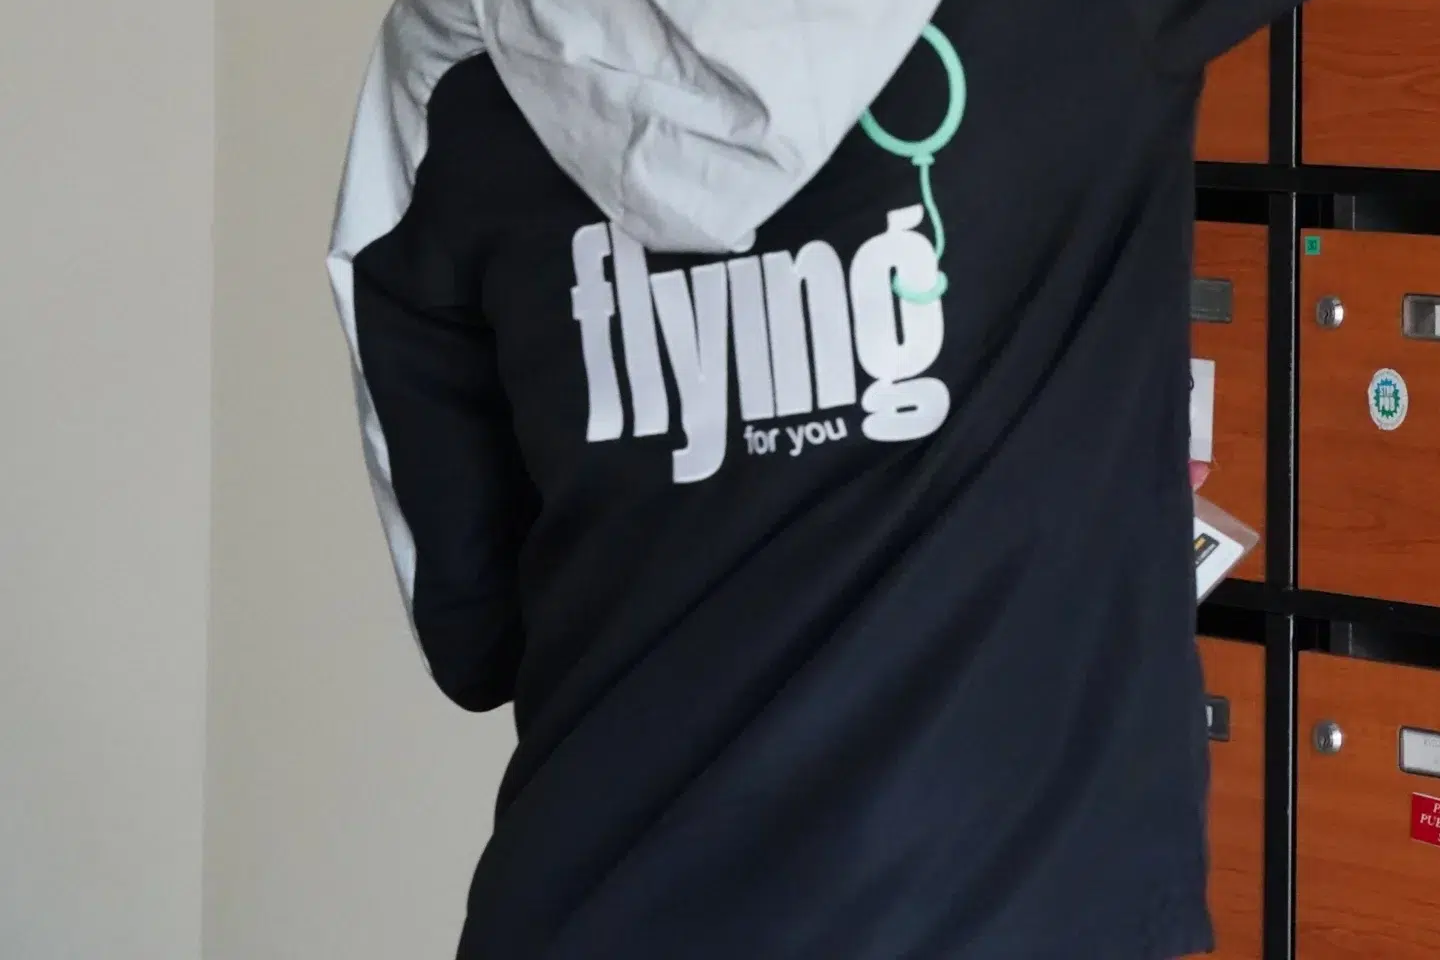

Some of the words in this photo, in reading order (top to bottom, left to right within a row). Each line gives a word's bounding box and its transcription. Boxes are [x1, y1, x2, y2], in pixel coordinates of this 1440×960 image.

[572, 204, 950, 484] flying
[743, 425, 779, 456] for
[785, 417, 848, 457] you
